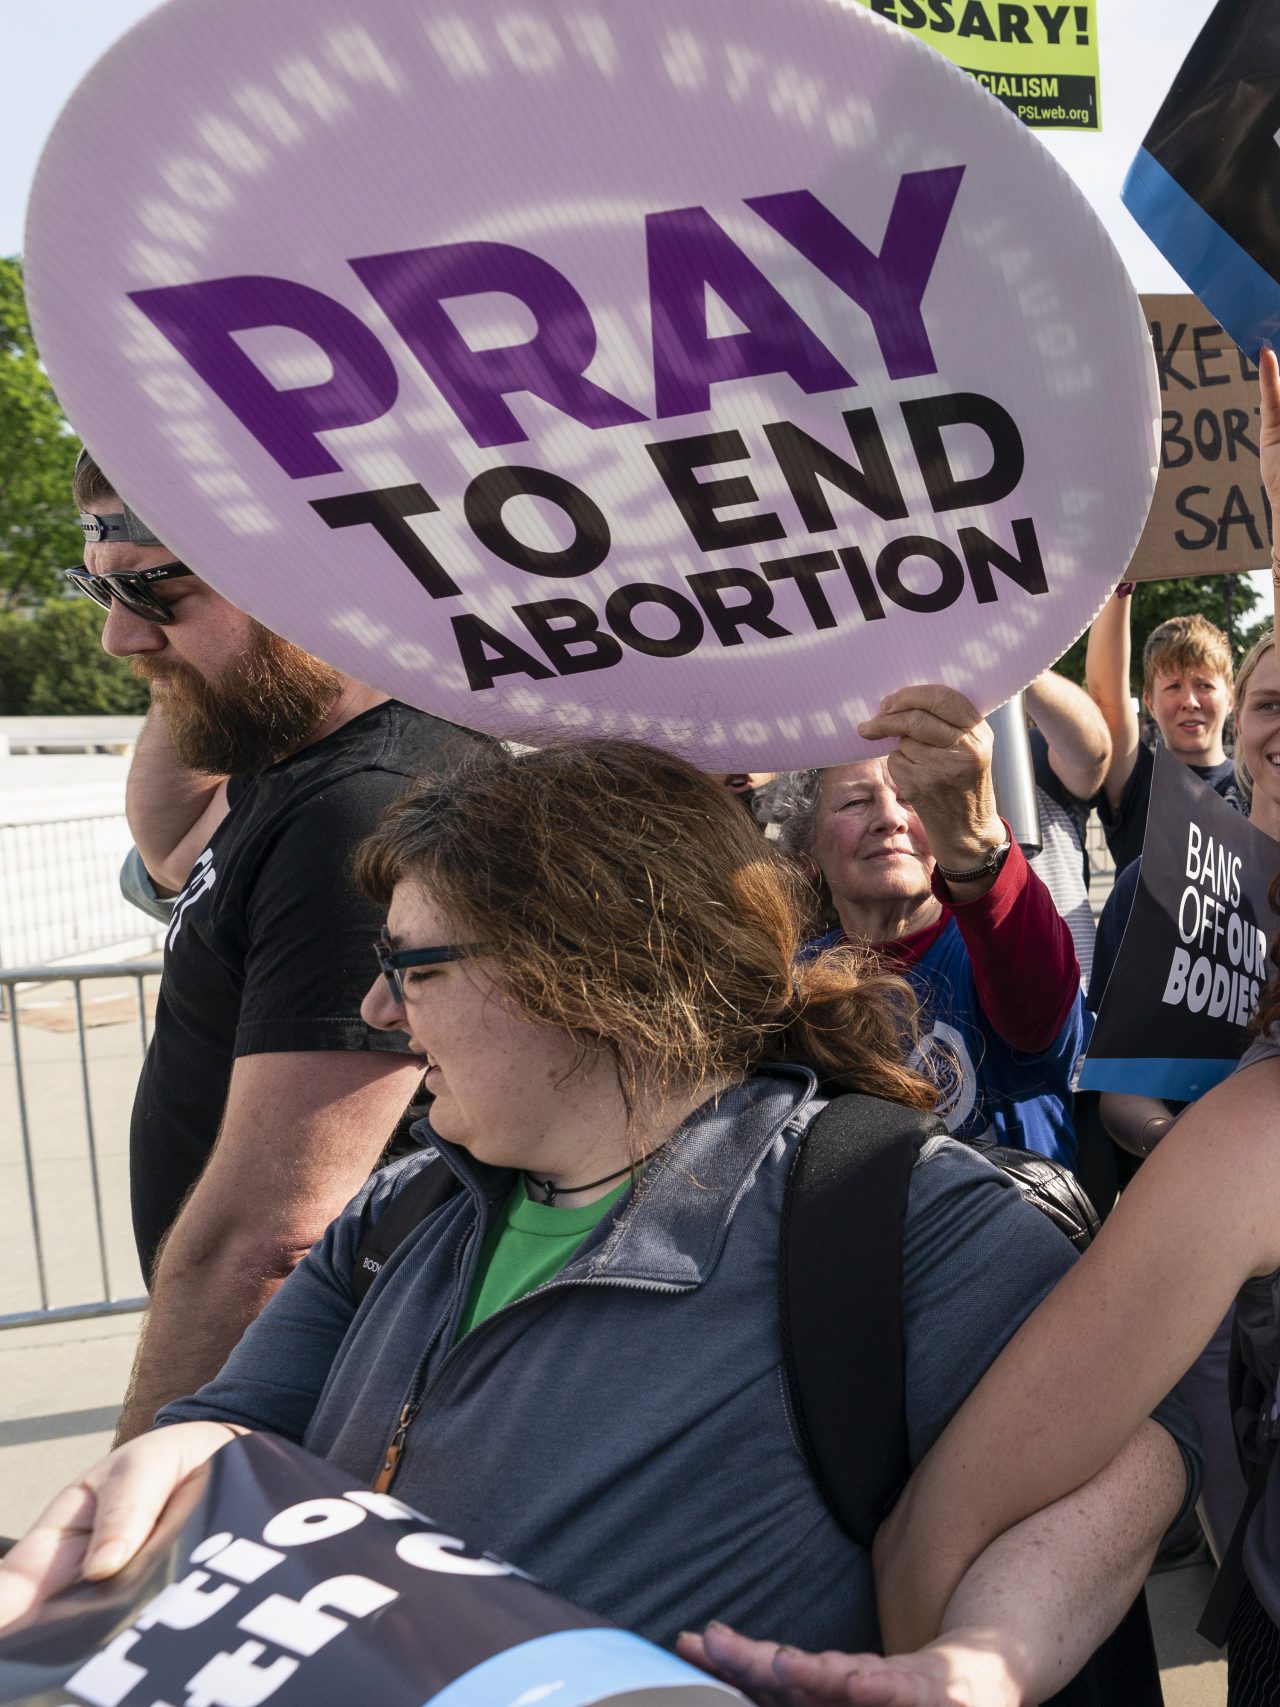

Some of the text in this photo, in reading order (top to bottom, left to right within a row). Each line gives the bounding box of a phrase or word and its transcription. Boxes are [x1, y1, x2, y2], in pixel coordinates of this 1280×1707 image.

[1017, 104, 1090, 124] PSLweb.org
[125, 164, 967, 480] PRAY
[308, 391, 1025, 600] TO END
[449, 517, 1050, 692] ABORTION
[1185, 821, 1242, 909] BANS
[1178, 885, 1267, 981] OFF OUR
